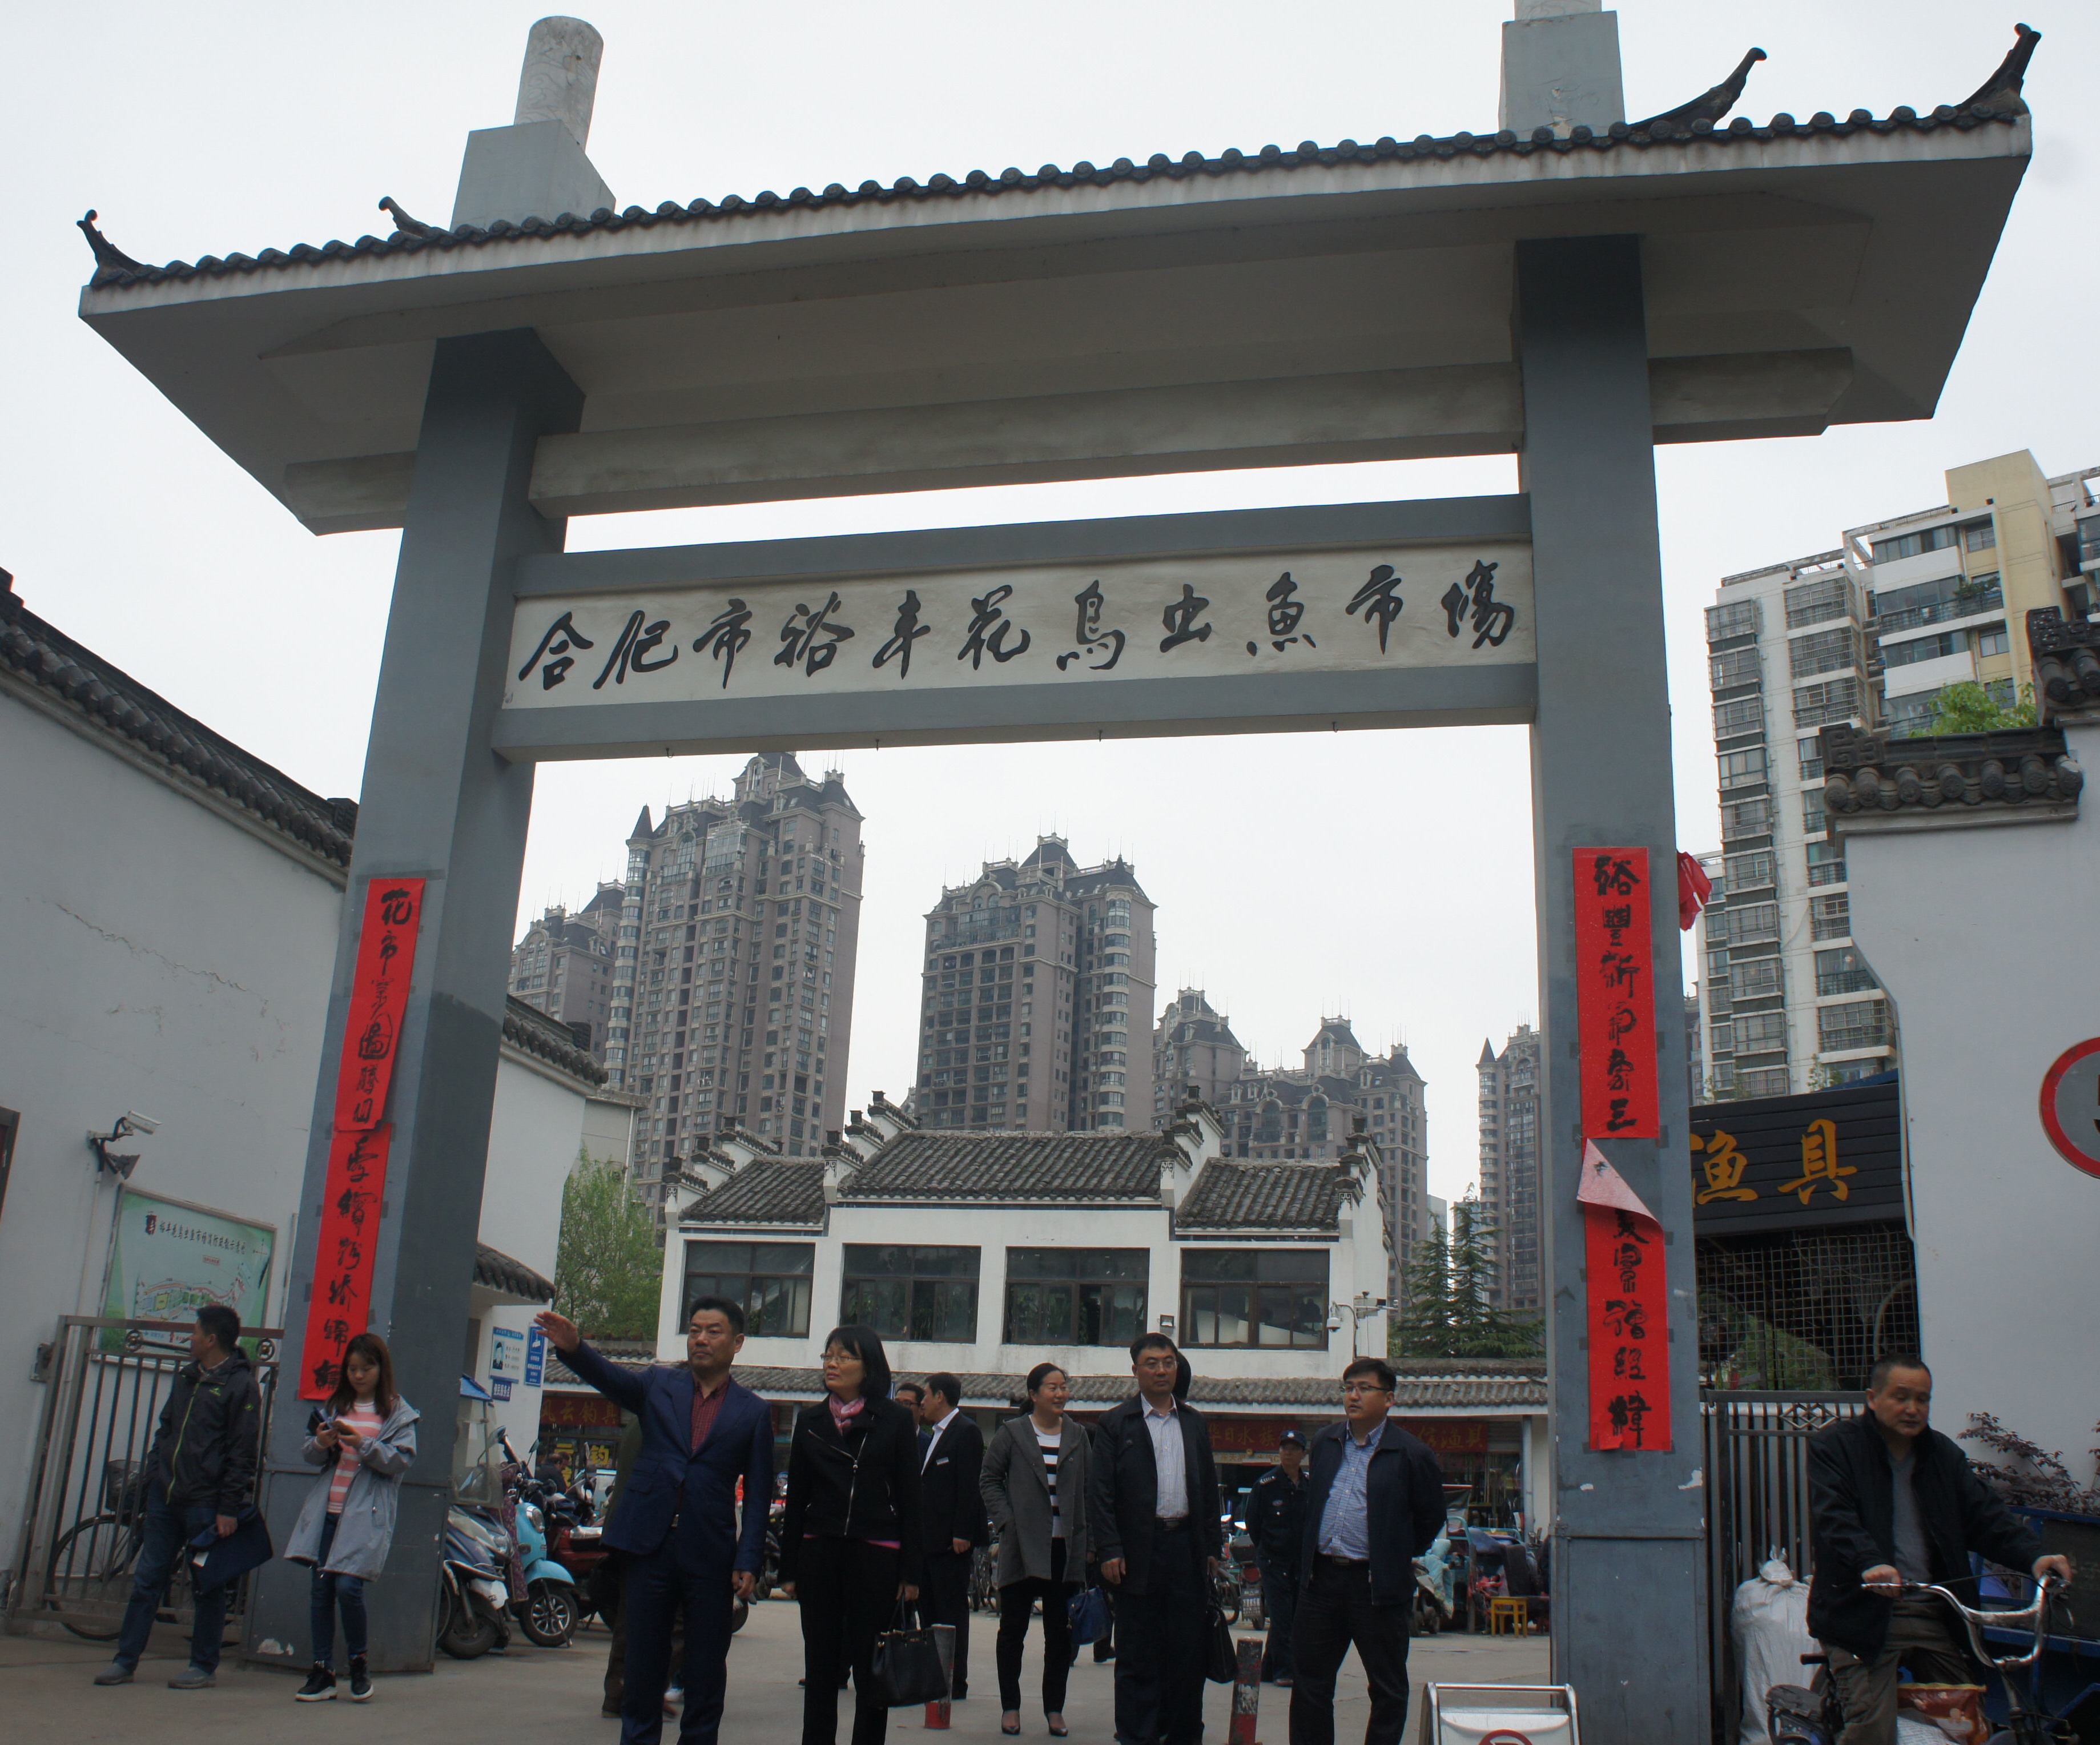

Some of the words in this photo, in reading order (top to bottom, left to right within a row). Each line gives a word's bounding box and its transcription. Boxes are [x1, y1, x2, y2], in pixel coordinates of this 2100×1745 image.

[1208, 1424, 1292, 1449] 华日水族
[1401, 1424, 1483, 1449] 信渔具
